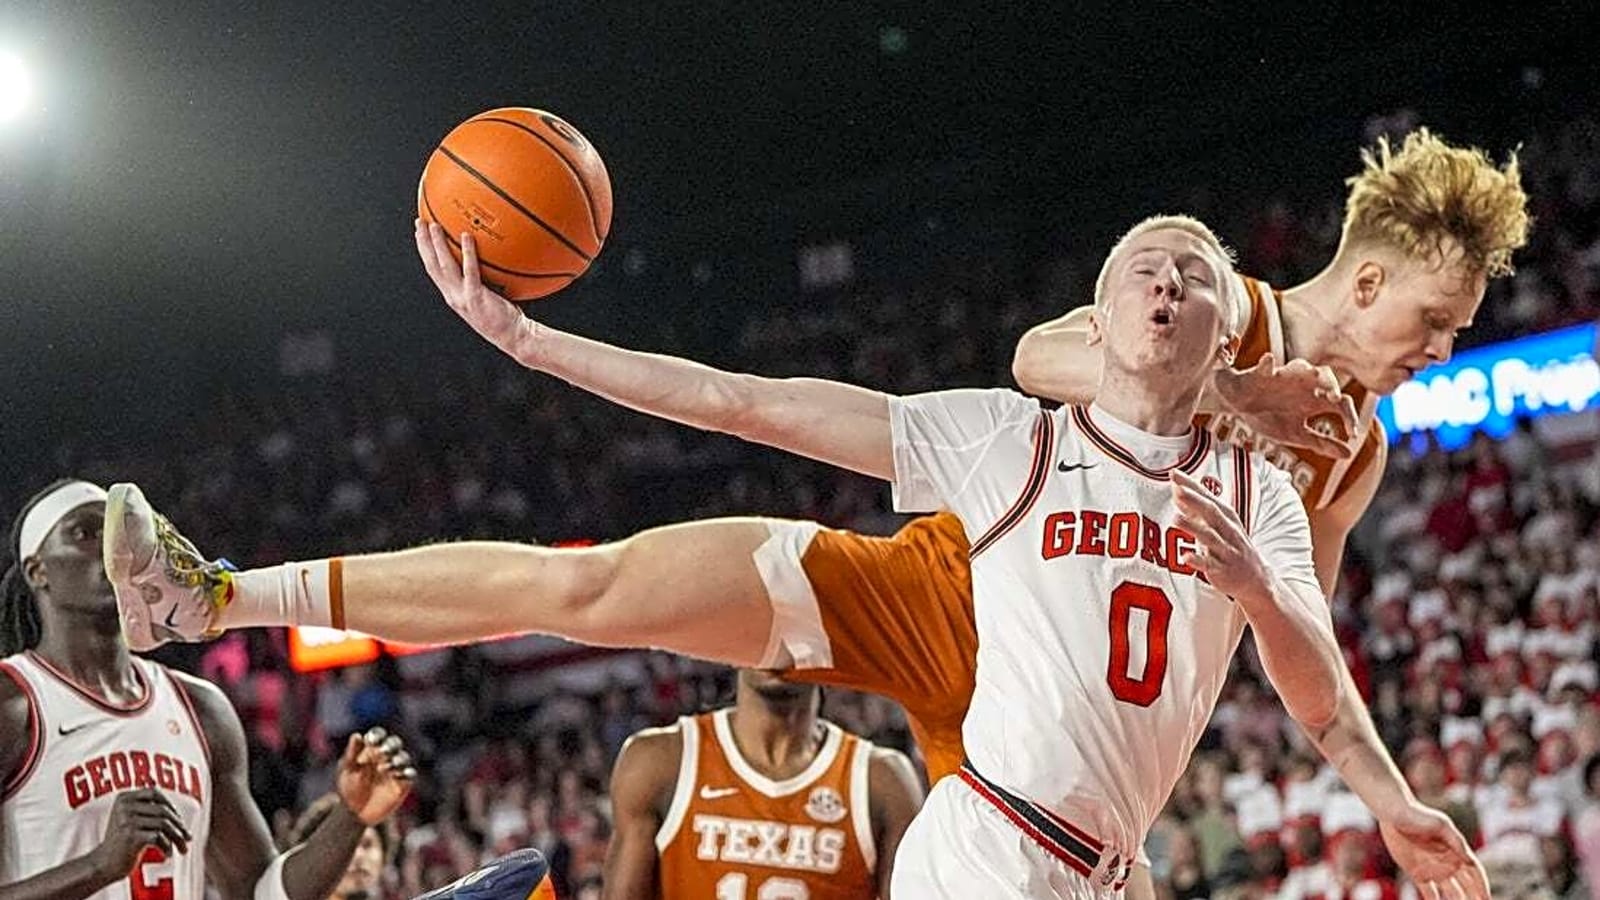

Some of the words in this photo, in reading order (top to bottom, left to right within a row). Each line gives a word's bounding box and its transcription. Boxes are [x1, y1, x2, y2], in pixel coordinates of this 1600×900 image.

[1041, 510, 1211, 586] GEORG
[1106, 580, 1174, 708] 0
[63, 750, 203, 809] GEORGIA
[693, 813, 848, 875] TEXAS
